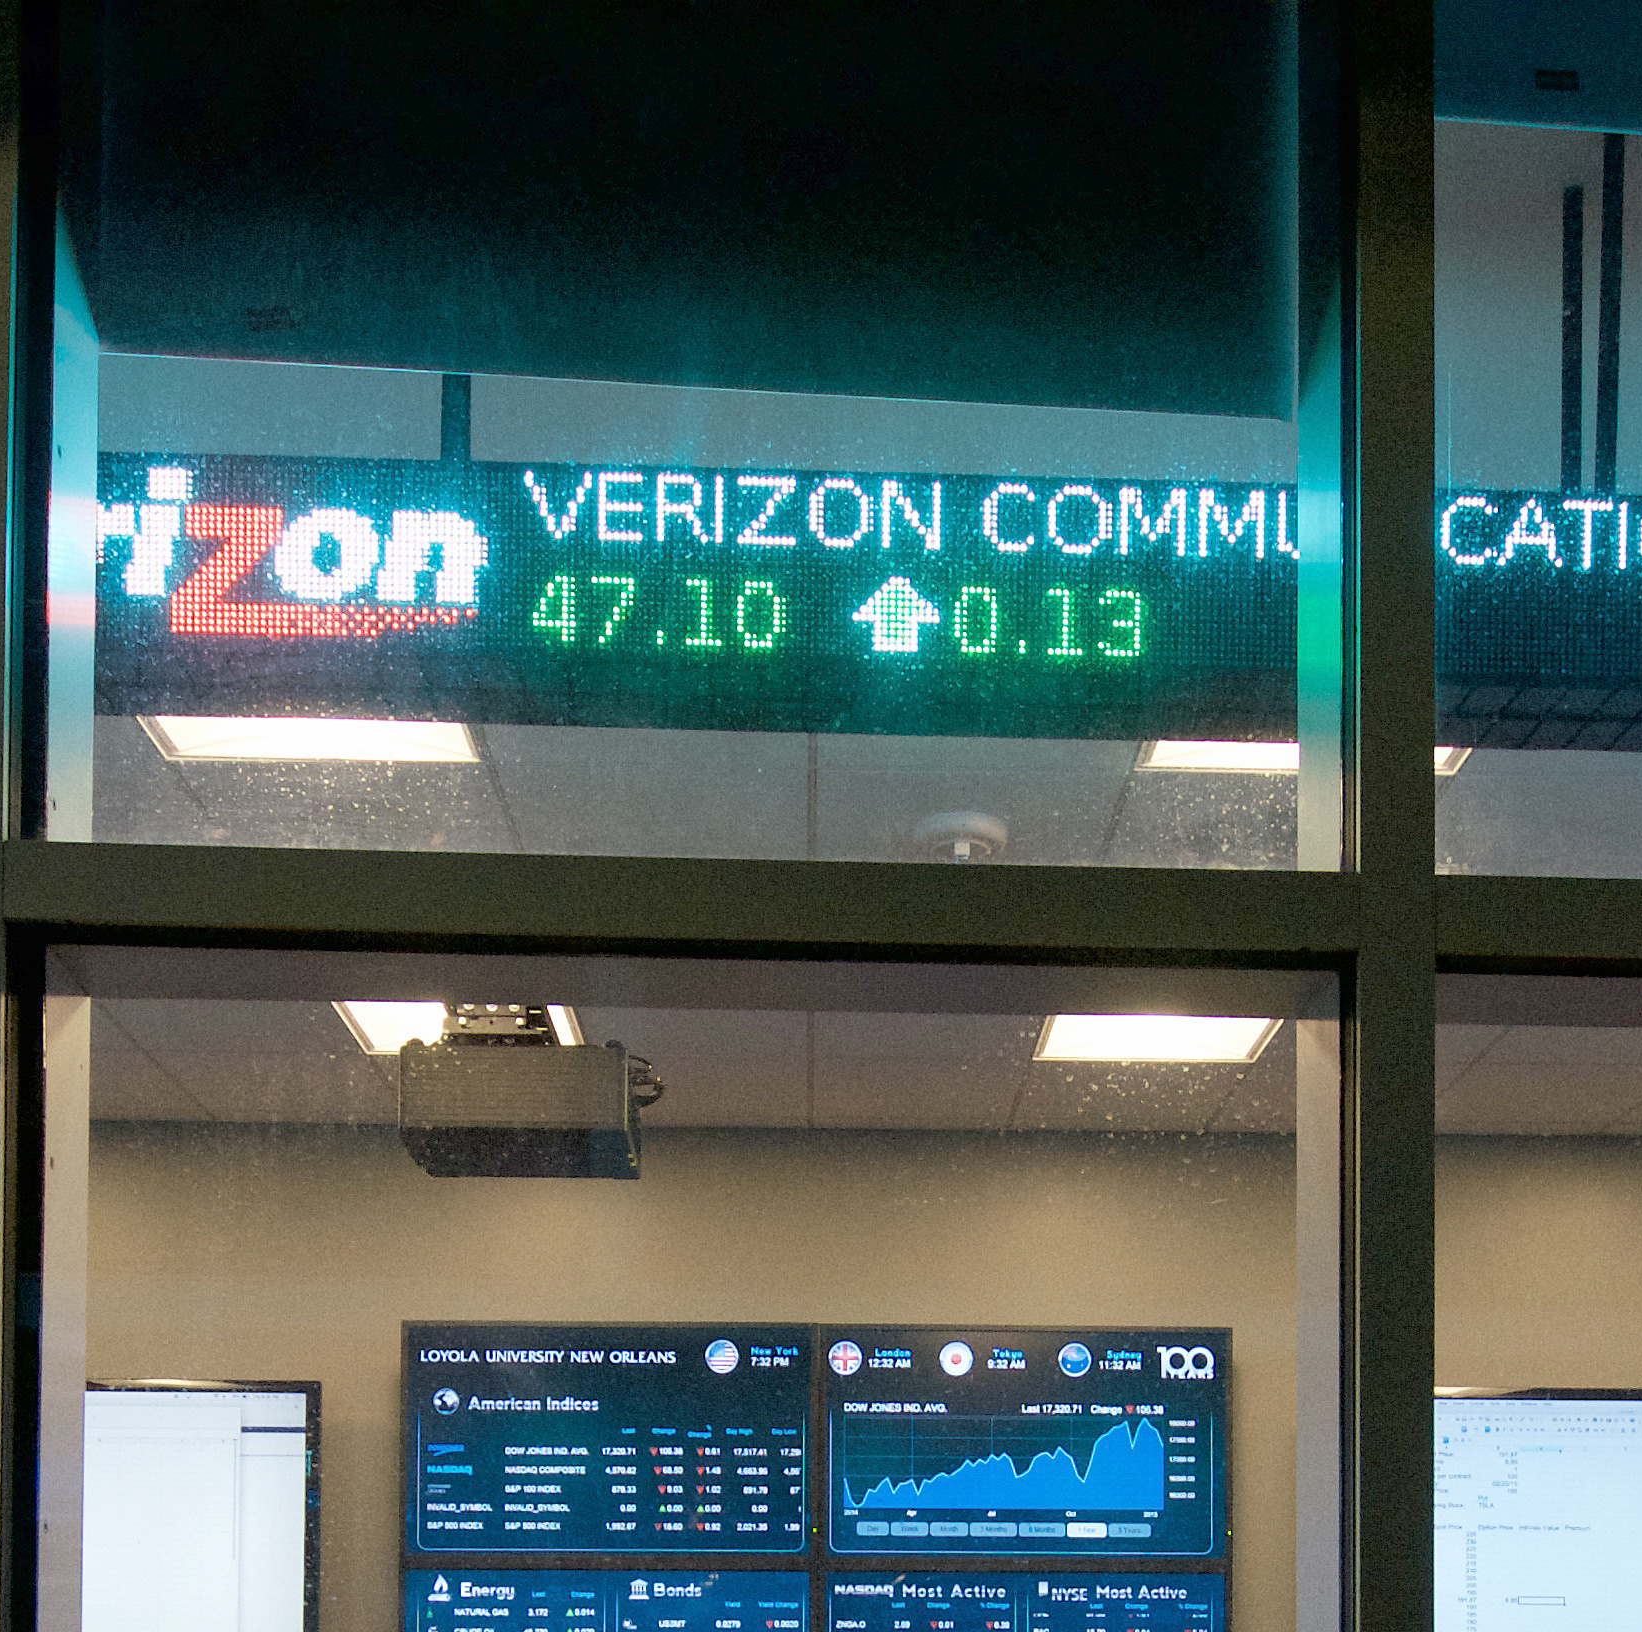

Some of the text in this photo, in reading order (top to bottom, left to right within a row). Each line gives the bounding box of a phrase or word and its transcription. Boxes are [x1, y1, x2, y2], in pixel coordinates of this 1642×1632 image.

[522, 470, 942, 551] VERIZON
[532, 575, 788, 650] 47.10
[954, 585, 1143, 657] 0.13
[751, 1346, 799, 1356] New York
[875, 1349, 912, 1358] London
[992, 1349, 1024, 1359] Tokyo
[1106, 1350, 1142, 1361] Sydney
[420, 1350, 677, 1364] LOYOLA UNIVERSITY NEW ORLEANS
[751, 1357, 790, 1367] 7:32 PM
[1157, 1346, 1215, 1376] 100
[868, 1359, 912, 1369] 12:32 AM
[987, 1359, 1026, 1369] 9:32 AM
[1099, 1360, 1142, 1370] 11:32 AM
[1167, 1370, 1215, 1379] YEARS
[468, 1396, 599, 1411] American Indices
[844, 1403, 868, 1413] DOW
[869, 1403, 901, 1413] JONES
[924, 1404, 948, 1413] AVG.
[1022, 1404, 1040, 1414] Last
[1091, 1405, 1122, 1416] Change
[460, 1582, 515, 1600] Energy
[653, 1582, 702, 1598] Bonds
[834, 1584, 1006, 1598] NASDAQ Most Active
[1051, 1585, 1187, 1601] NYSE Most Active
